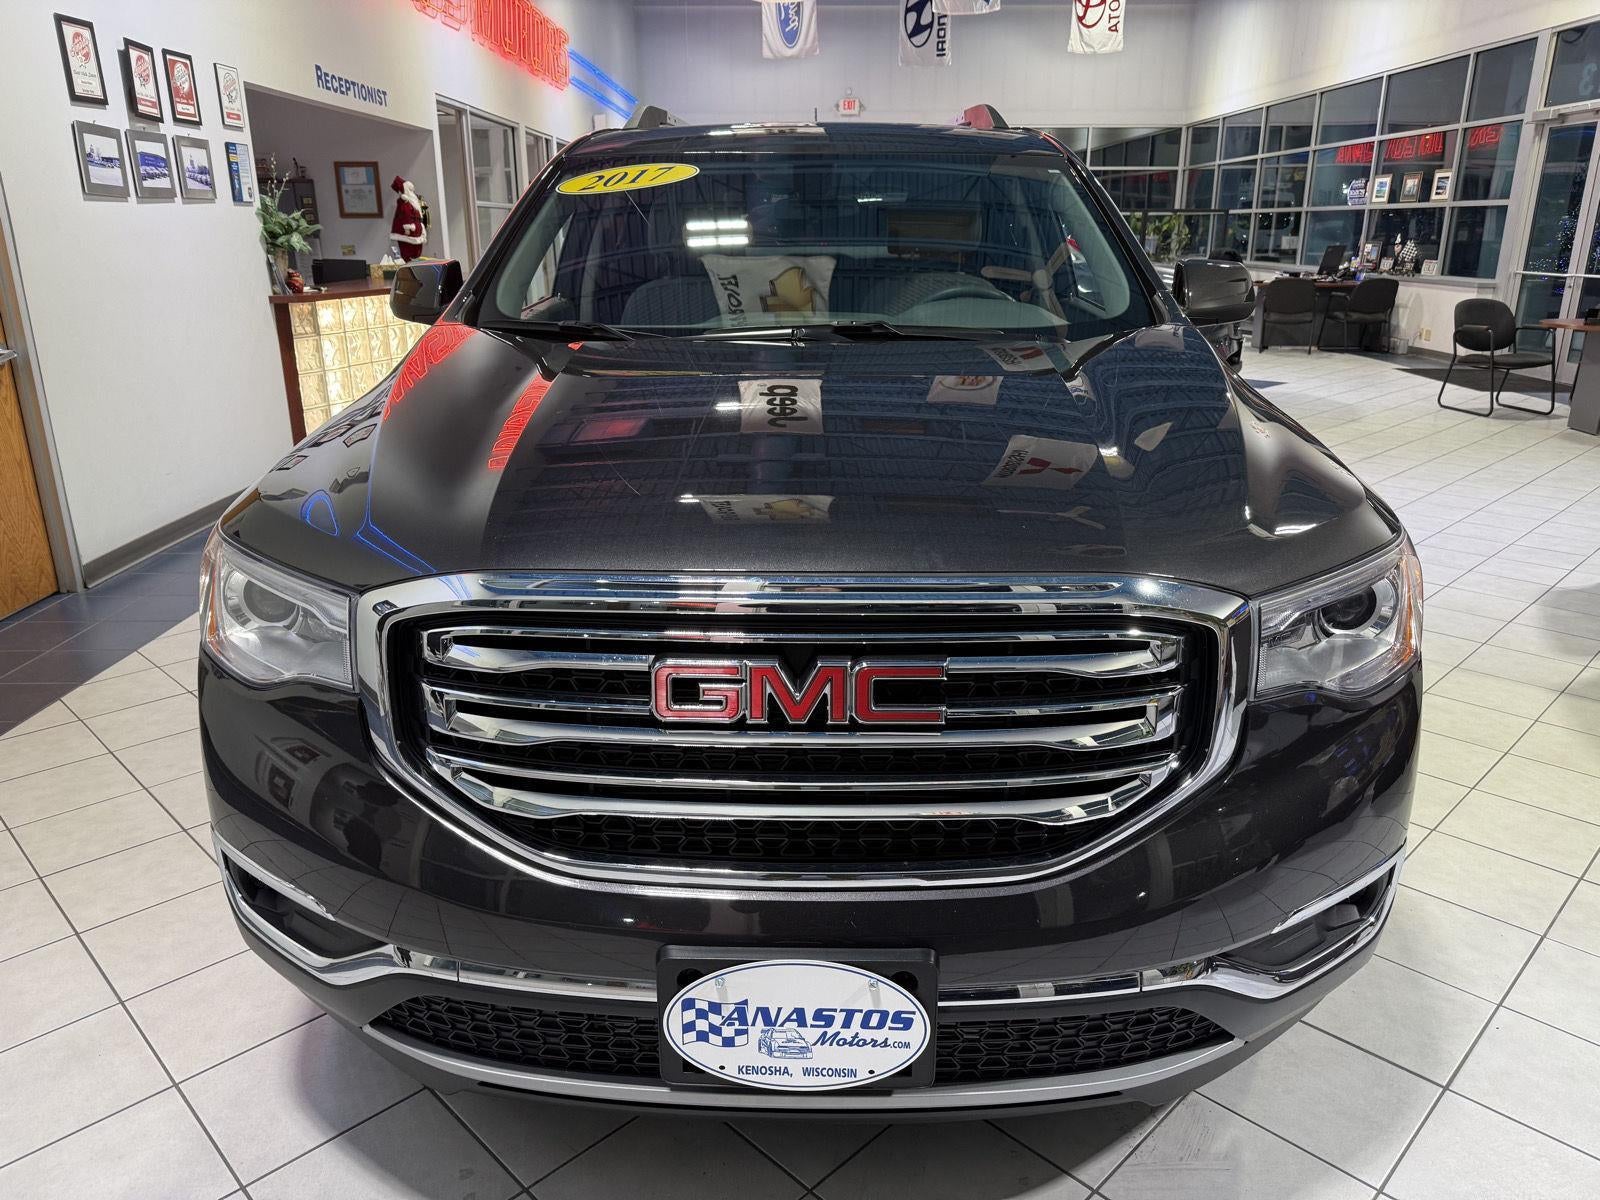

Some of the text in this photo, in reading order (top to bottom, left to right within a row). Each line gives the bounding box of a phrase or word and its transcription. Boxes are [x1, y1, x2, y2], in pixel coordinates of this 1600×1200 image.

[315, 64, 387, 107] RECEPTIONIST
[842, 100, 856, 111] EXIT
[577, 166, 676, 191] 2017
[650, 655, 948, 724] GMC
[719, 1006, 916, 1031] ANASTOS
[737, 1065, 857, 1078] KENOSHA, WISCONSIN
